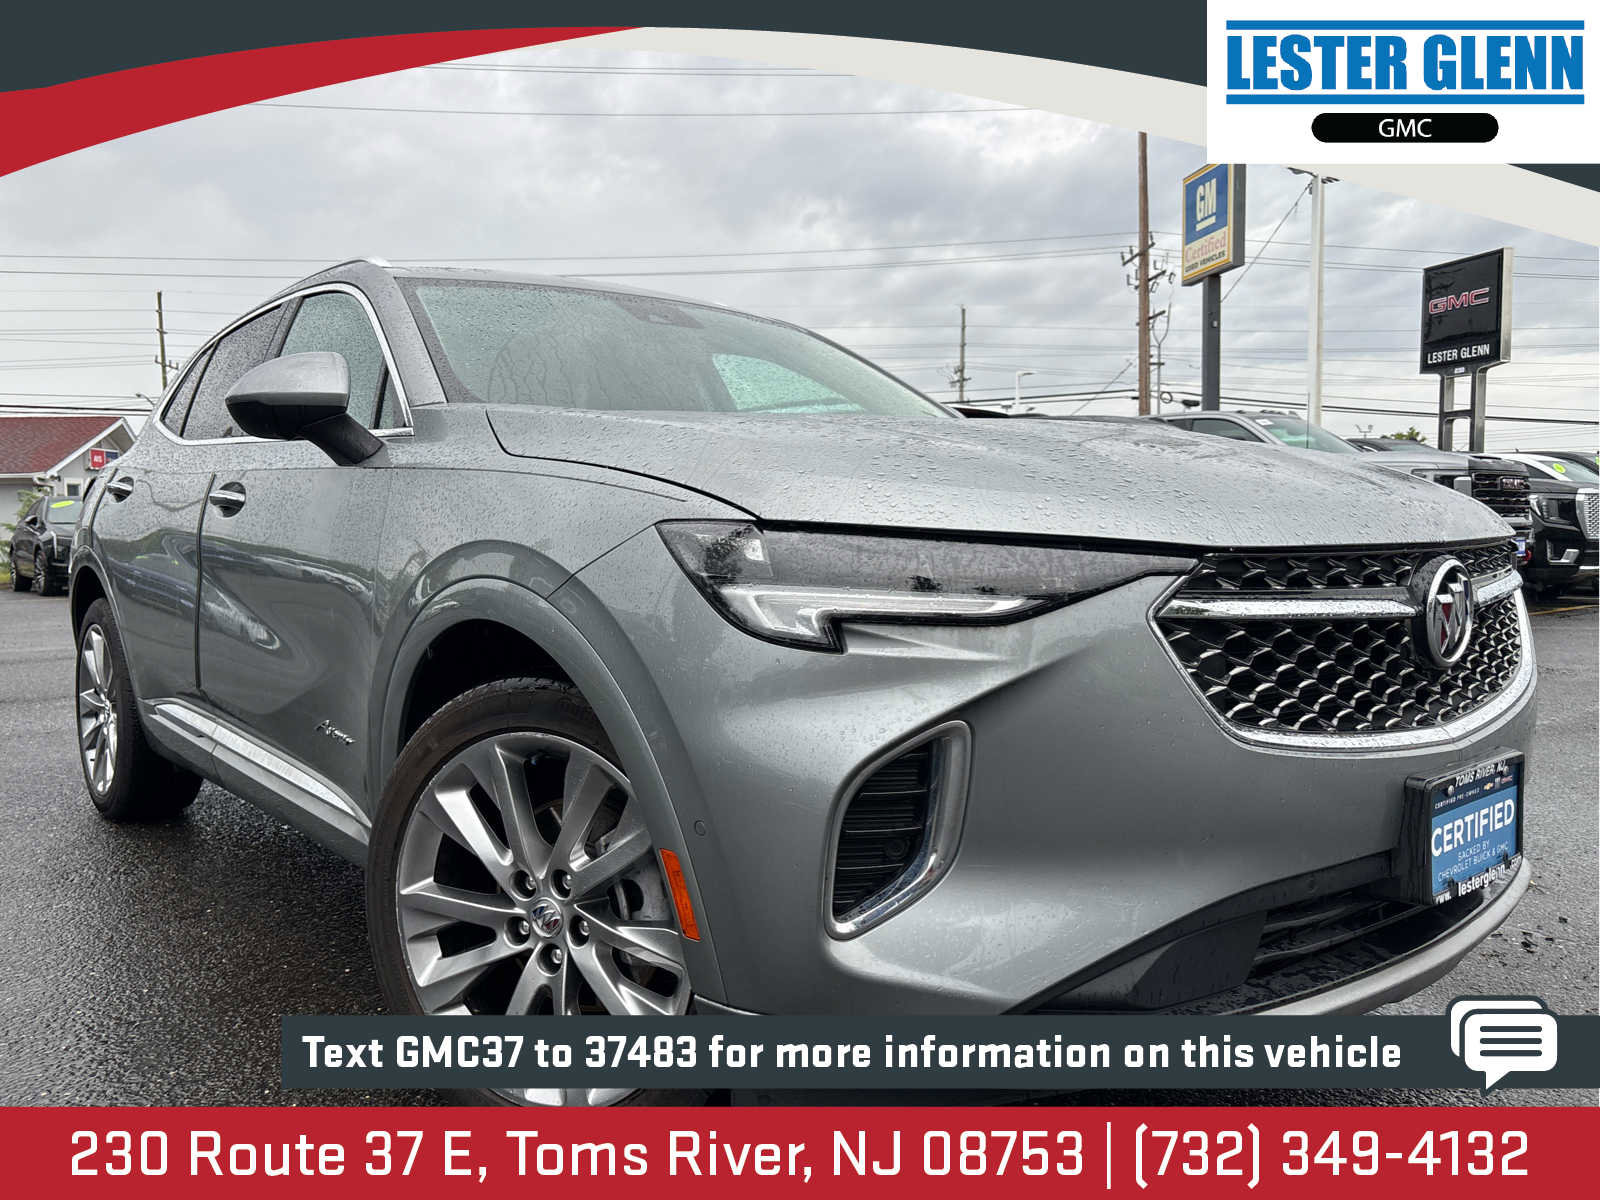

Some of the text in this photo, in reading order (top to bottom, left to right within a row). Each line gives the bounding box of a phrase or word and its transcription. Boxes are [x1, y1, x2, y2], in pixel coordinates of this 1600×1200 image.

[1195, 178, 1217, 222] GM
[1184, 229, 1226, 264] Certified
[1428, 287, 1490, 314] GMC
[1427, 343, 1490, 364] LESTER GLENN
[1455, 771, 1475, 788] TOMS
[1431, 799, 1515, 857] CERTIFIED
[1482, 839, 1490, 851] BY
[1438, 859, 1472, 882] CHEVROLET
[1473, 850, 1491, 865] BUICK
